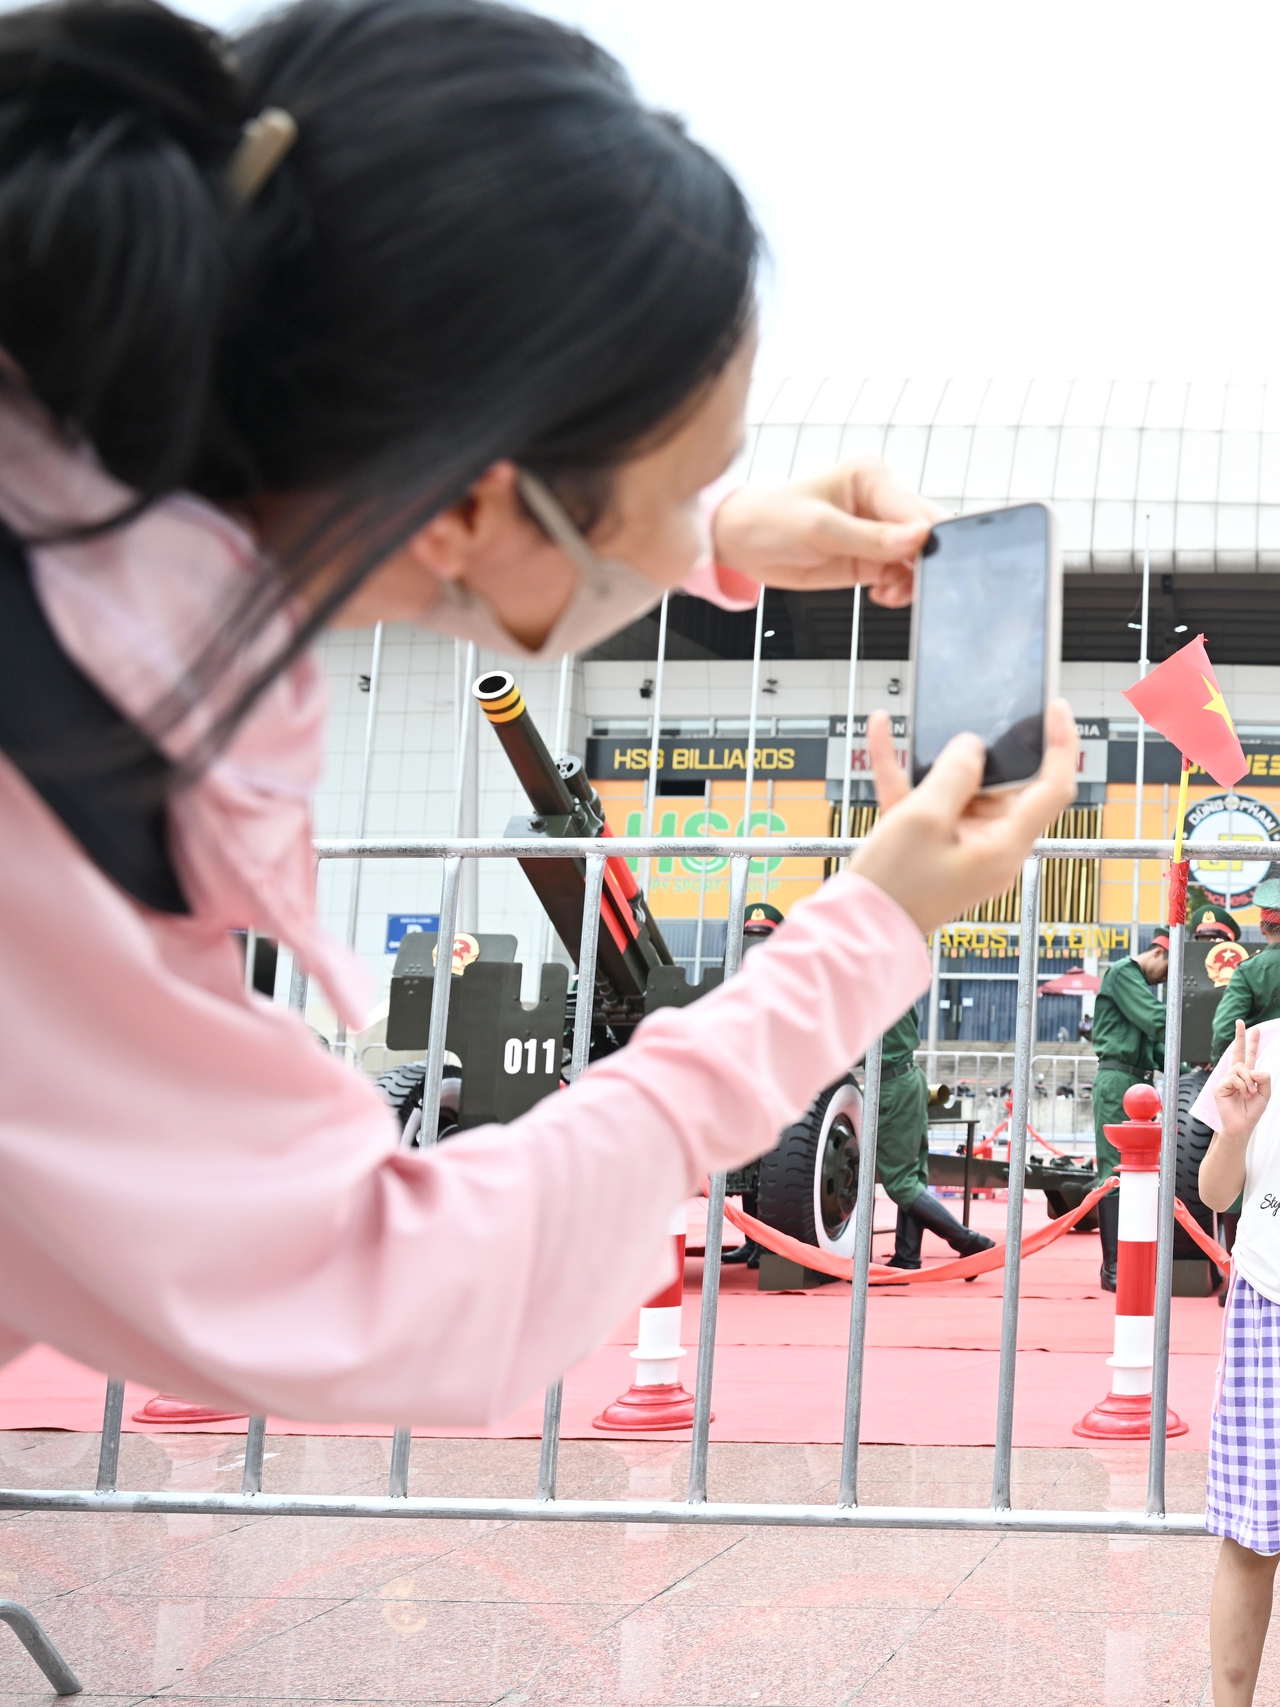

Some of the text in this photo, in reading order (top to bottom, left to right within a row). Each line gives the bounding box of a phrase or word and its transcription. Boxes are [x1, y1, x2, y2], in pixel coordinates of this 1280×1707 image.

[614, 748, 795, 770] HSG BILLIARDS
[673, 879, 722, 893] SPORT
[726, 879, 780, 893] OUP
[503, 1038, 556, 1075] 011
